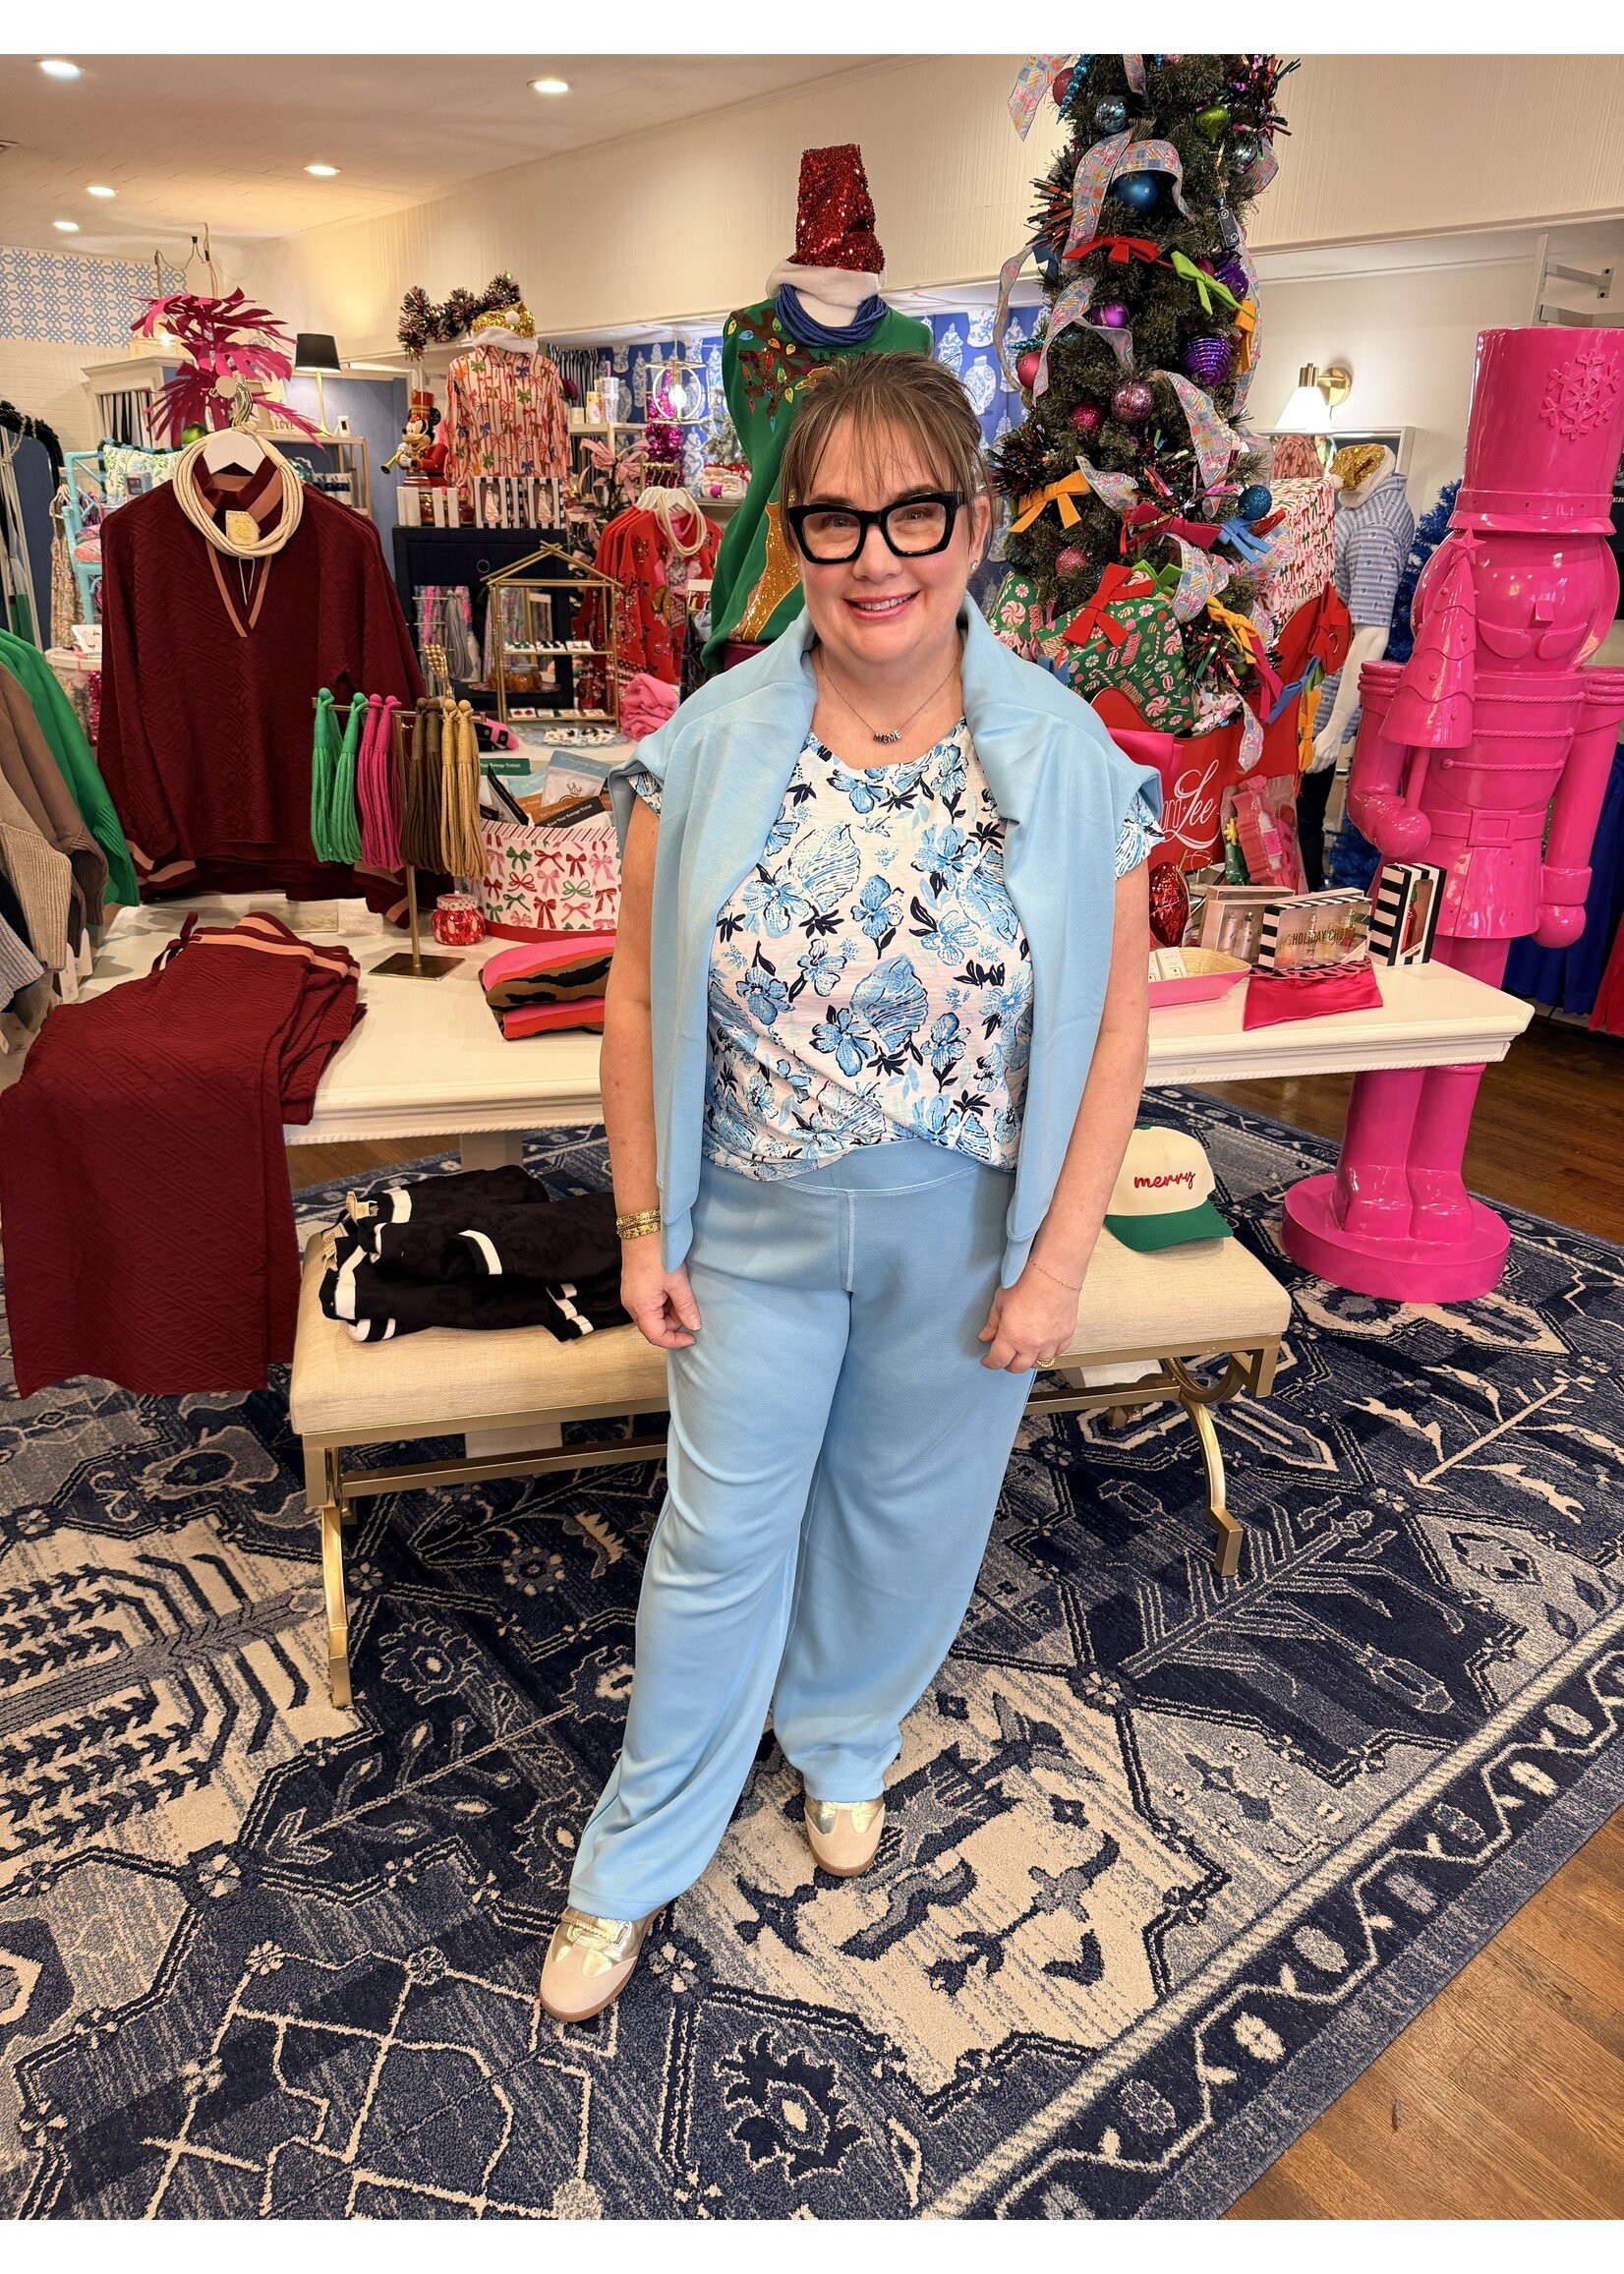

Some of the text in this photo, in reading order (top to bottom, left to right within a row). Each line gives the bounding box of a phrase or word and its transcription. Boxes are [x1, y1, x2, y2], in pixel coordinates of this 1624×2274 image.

[1162, 759, 1220, 850] Lee
[1292, 929, 1326, 946] HOLIDAY
[1133, 1170, 1196, 1191] merry
